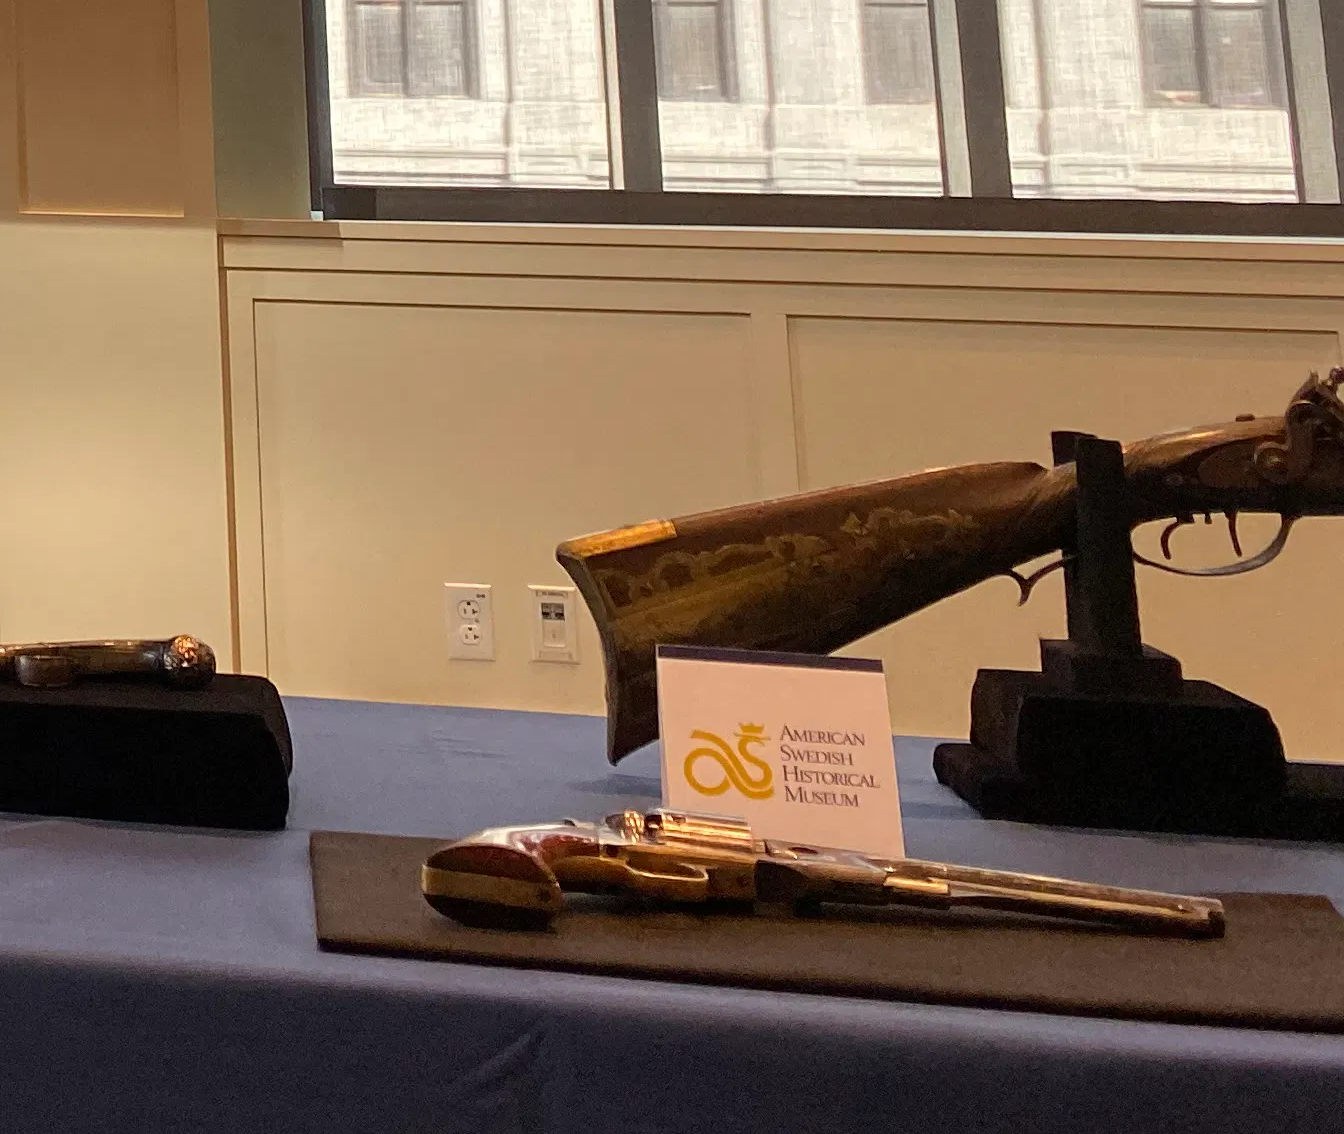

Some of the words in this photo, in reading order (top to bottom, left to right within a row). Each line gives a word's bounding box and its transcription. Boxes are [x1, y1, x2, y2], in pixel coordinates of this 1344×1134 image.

[779, 724, 866, 747] AMERICAN
[780, 745, 854, 766] SWEDISH
[781, 765, 881, 789] HISTORICAL
[784, 785, 860, 808] MUSEUM
